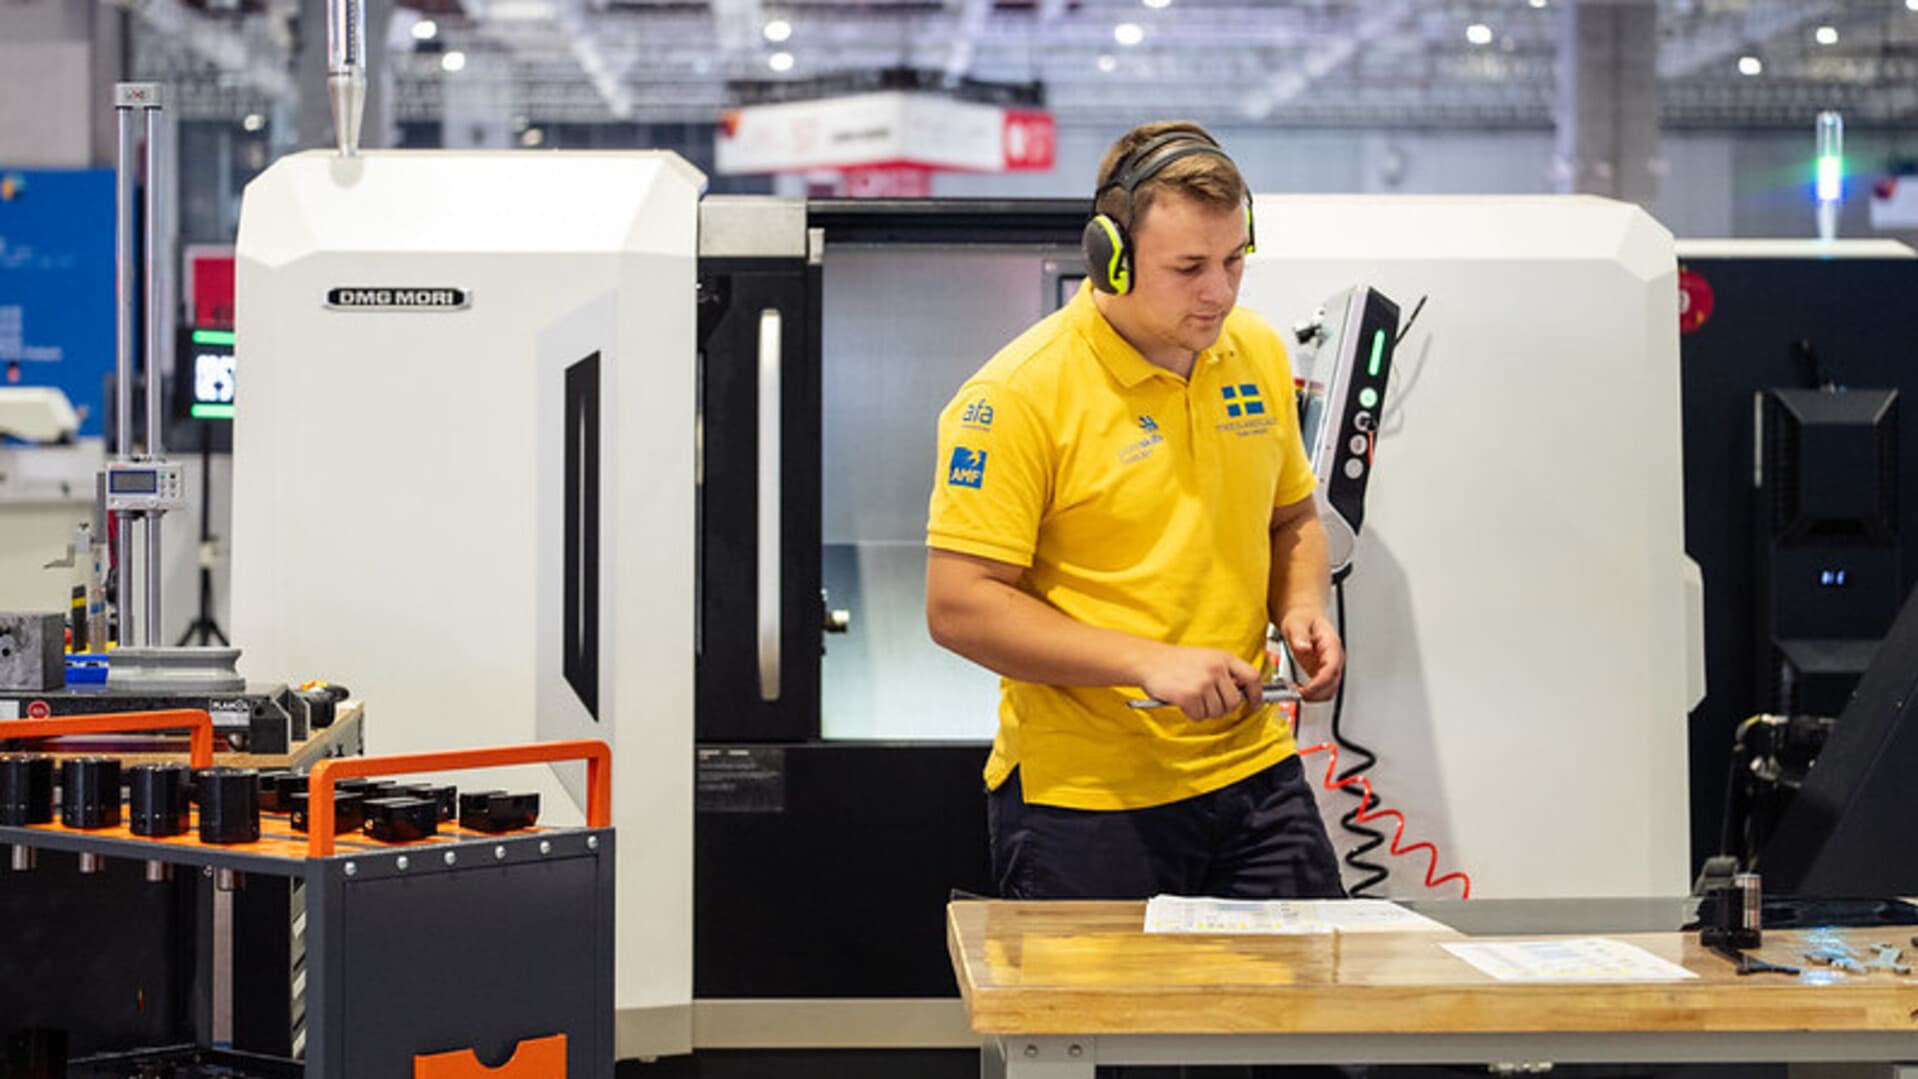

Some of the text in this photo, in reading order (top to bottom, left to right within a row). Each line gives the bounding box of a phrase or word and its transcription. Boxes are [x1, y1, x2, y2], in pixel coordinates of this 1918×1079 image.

[339, 290, 454, 305] DMG MORI
[962, 398, 994, 425] afa
